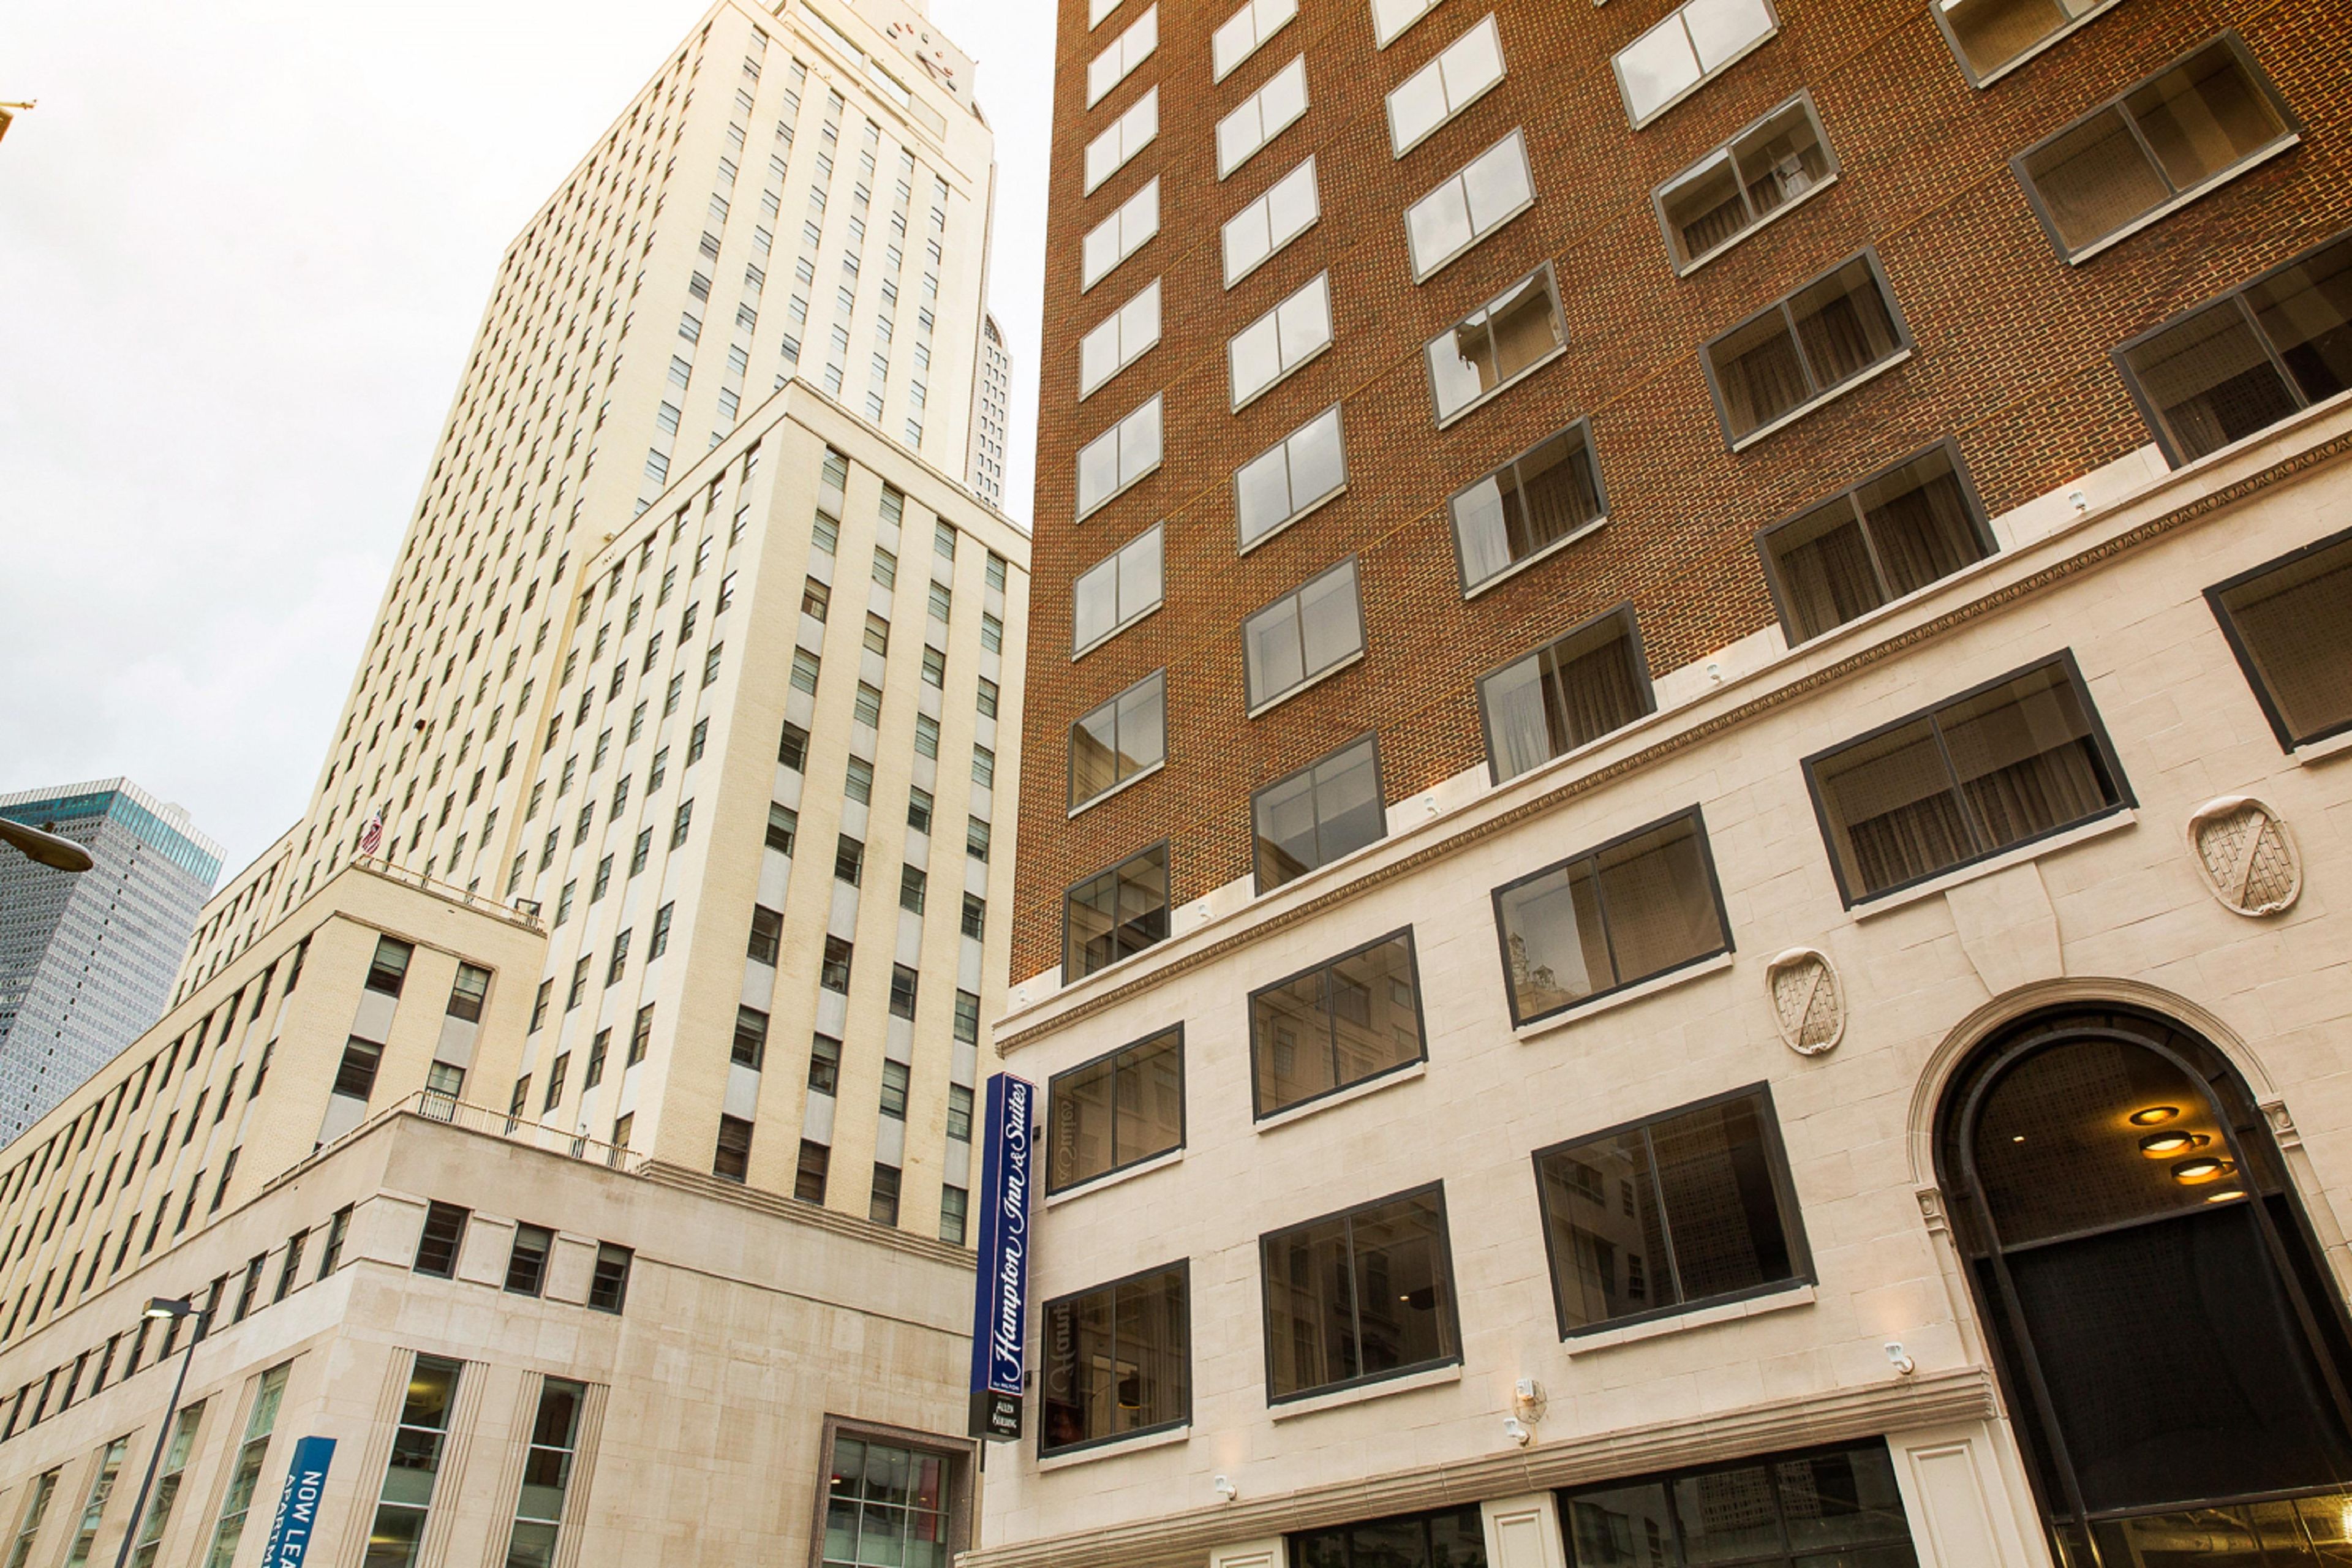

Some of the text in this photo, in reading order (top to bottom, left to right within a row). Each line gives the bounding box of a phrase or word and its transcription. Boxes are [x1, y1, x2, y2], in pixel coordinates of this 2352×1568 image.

[1005, 1084, 1027, 1151] Suites
[1011, 1152, 1027, 1167] &
[1004, 1165, 1025, 1234] Inn
[994, 1236, 1023, 1382] Hampton
[263, 1474, 296, 1568] APARTM
[292, 1471, 322, 1523] NOW
